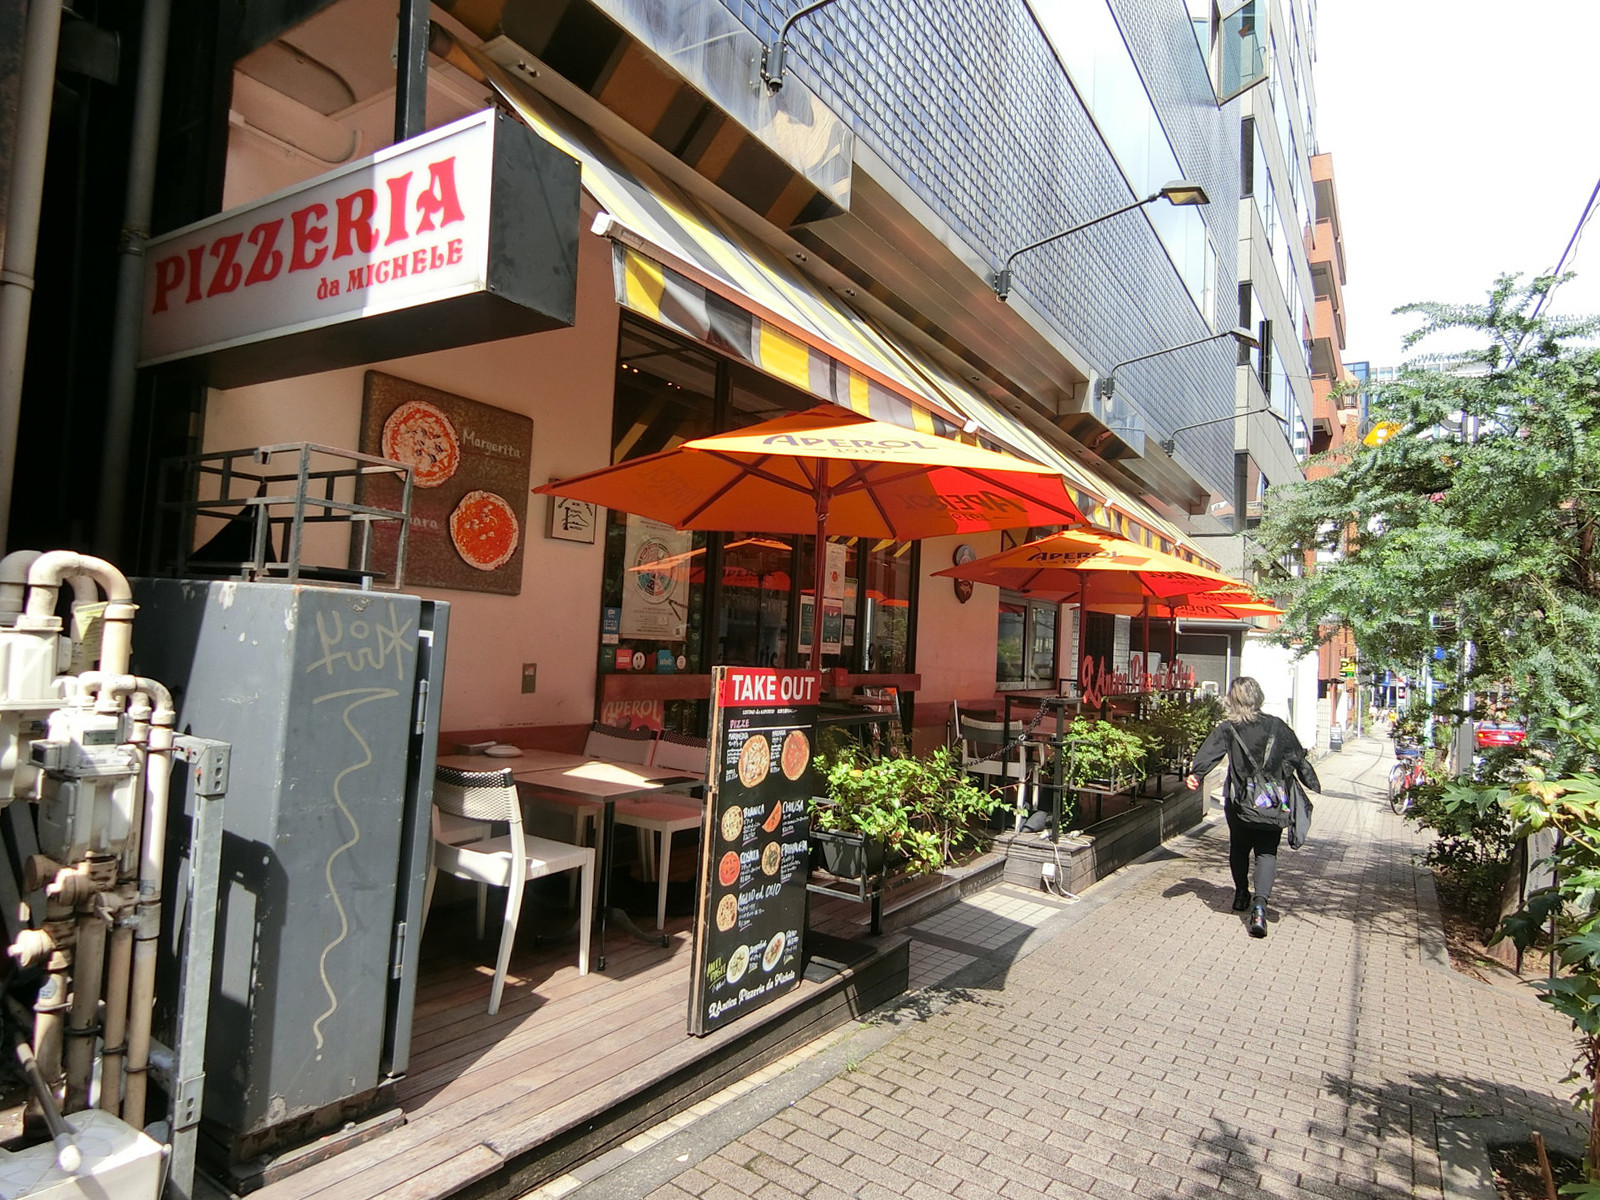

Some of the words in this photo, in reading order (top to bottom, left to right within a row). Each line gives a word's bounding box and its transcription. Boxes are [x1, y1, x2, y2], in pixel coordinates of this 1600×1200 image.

[152, 156, 466, 315] PIZZERIA
[346, 238, 463, 293] MICHELE
[462, 429, 522, 458] Margerita
[762, 434, 938, 450] APEROL
[732, 674, 777, 701] TAKE
[780, 676, 815, 700] OUT
[603, 700, 662, 723] APEROL
